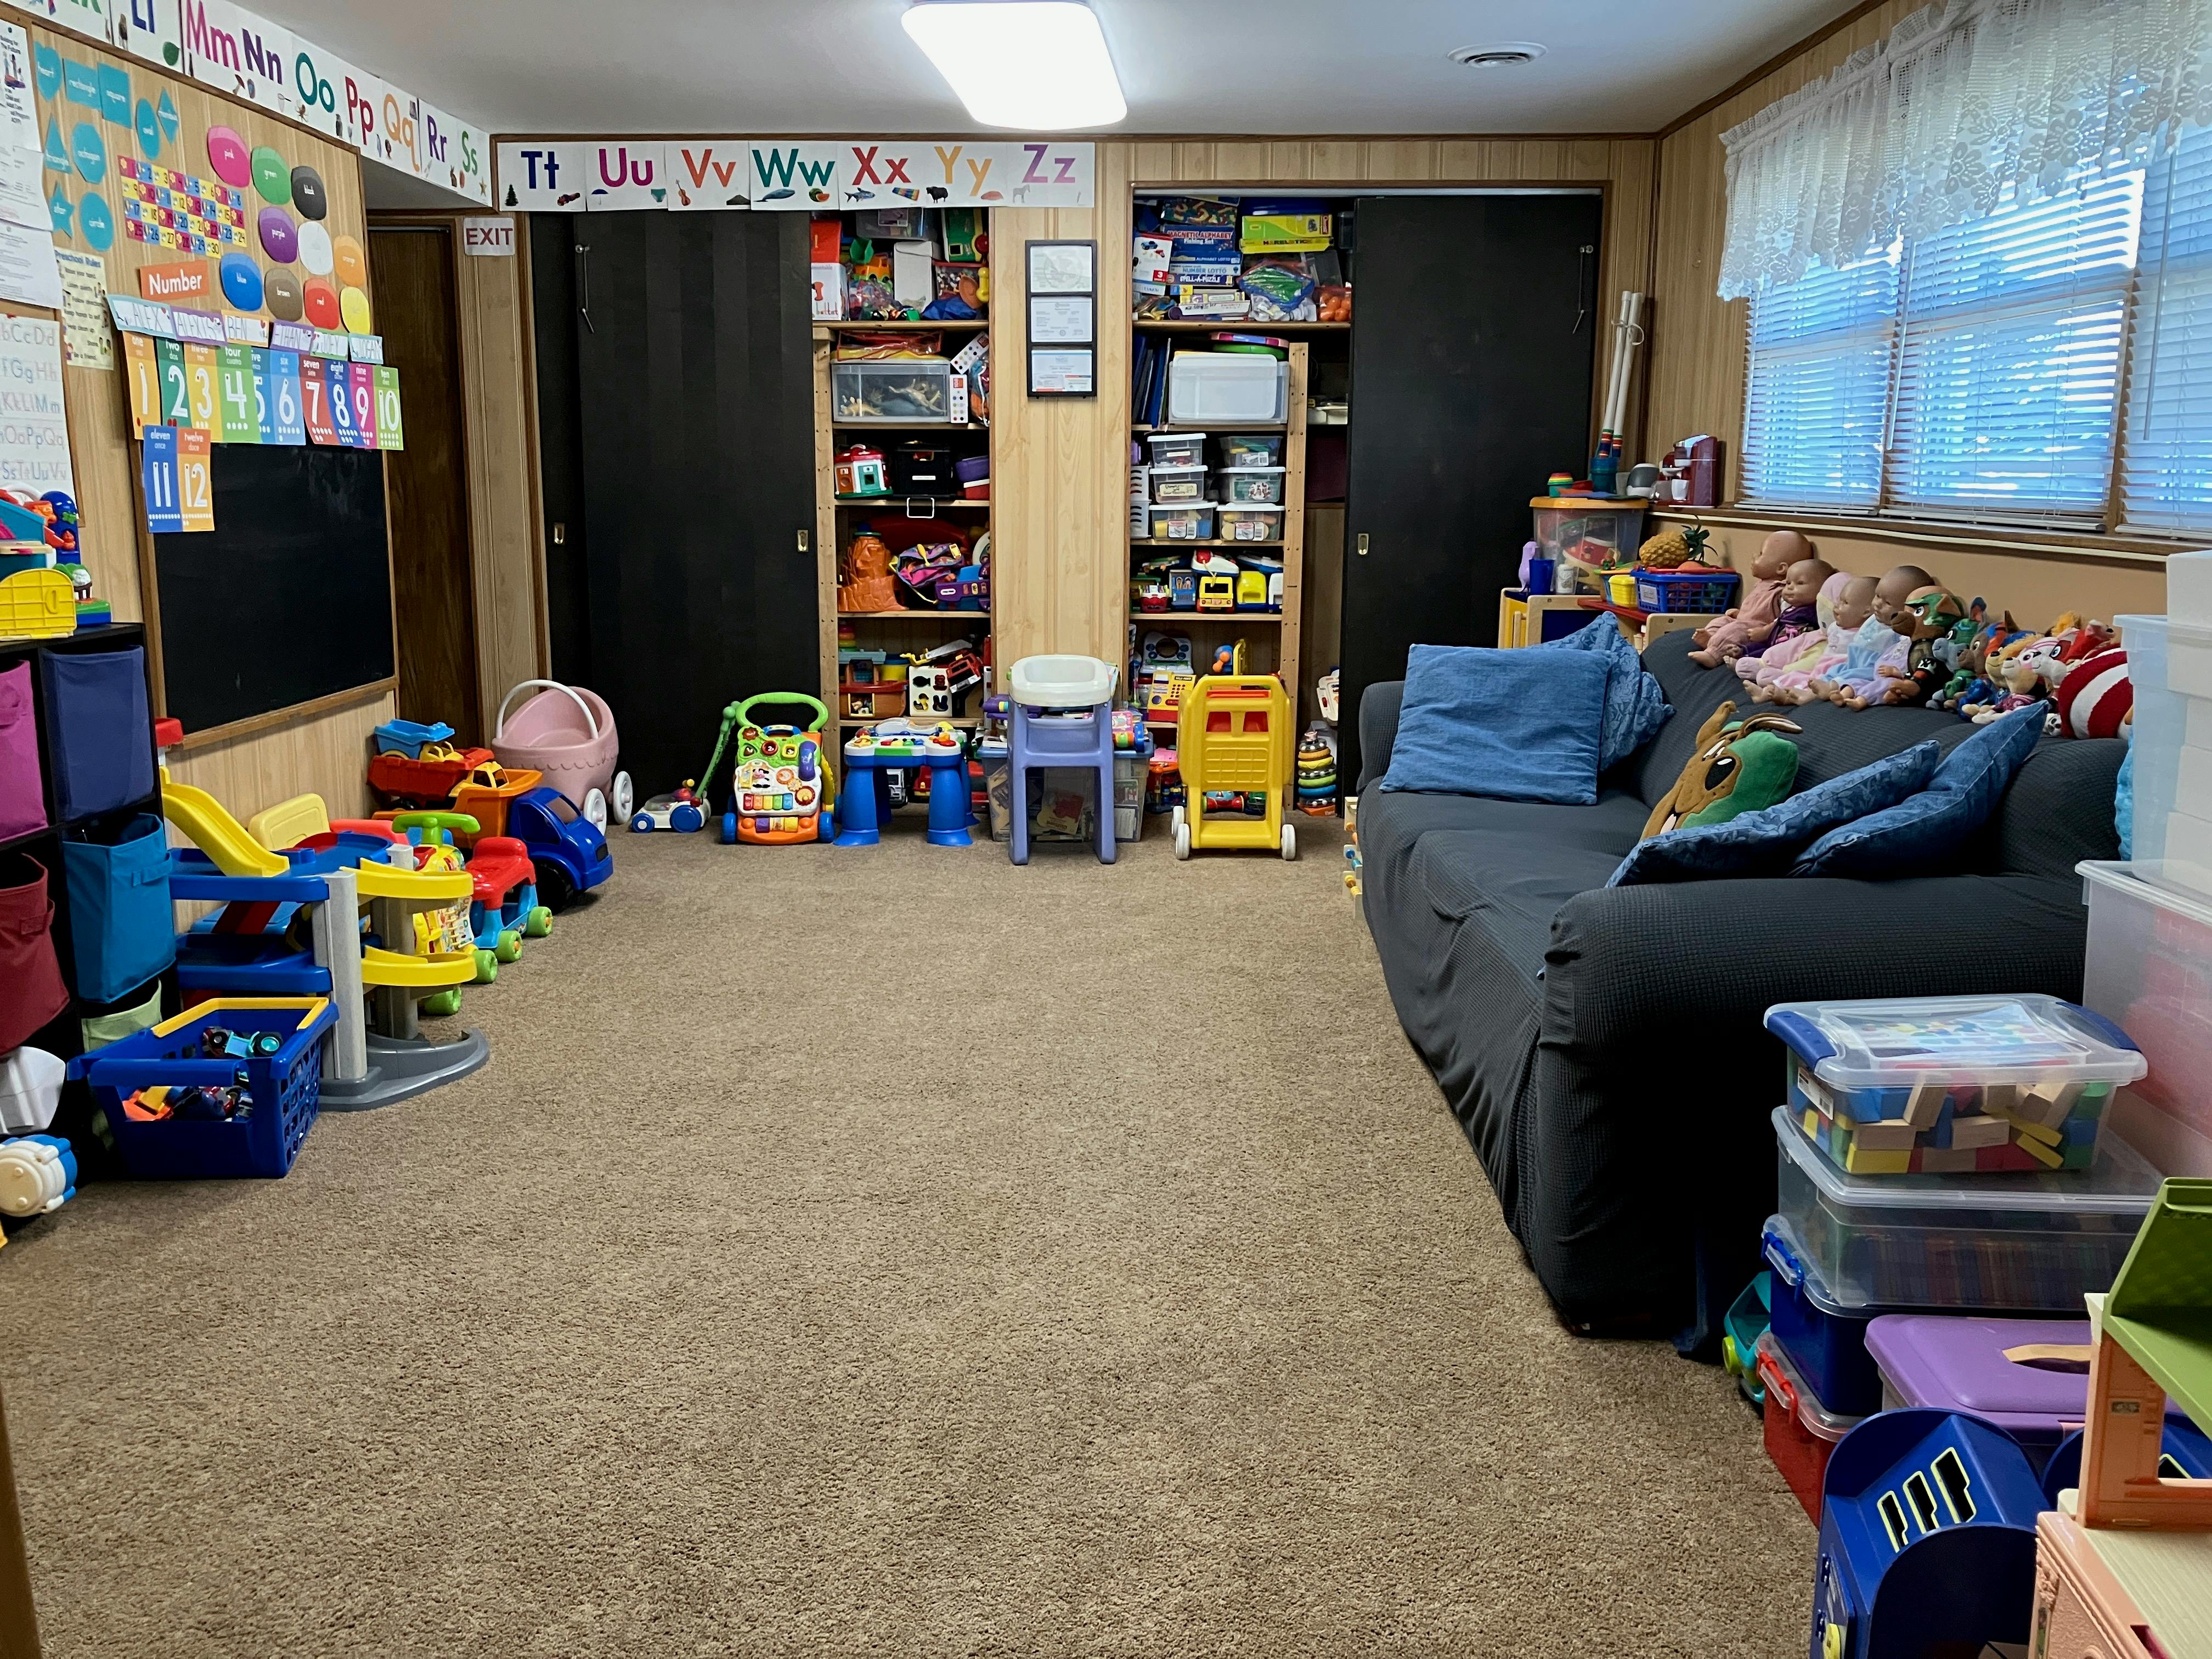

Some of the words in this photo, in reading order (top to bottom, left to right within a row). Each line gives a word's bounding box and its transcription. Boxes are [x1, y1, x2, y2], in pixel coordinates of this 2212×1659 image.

[187, 0, 241, 72] Mm
[242, 28, 283, 85] Nn
[296, 52, 335, 113] Oo
[345, 76, 374, 145] Pp
[384, 93, 420, 172] Qq
[427, 114, 447, 163] Rr
[461, 131, 478, 176] Ss
[148, 168, 152, 180] 2
[163, 173, 168, 184] 3
[194, 182, 199, 193] 5
[210, 187, 214, 197] 6
[237, 195, 241, 205] 8
[521, 151, 560, 189] Tt
[599, 148, 654, 188] Uu
[681, 149, 736, 188] Vv
[752, 148, 836, 188] Ww
[851, 146, 912, 185] Xx
[934, 145, 992, 197] Yy
[1022, 144, 1076, 184] Zz
[133, 184, 137, 193] 9
[179, 197, 185, 209] 12
[210, 205, 216, 216] 14
[134, 204, 140, 215] 17
[151, 208, 157, 221] 18
[180, 216, 188, 228] 20
[198, 220, 203, 232] 21
[225, 227, 232, 239] 23
[238, 232, 245, 243] 24
[151, 228, 159, 240] 26
[167, 232, 174, 244] 27
[197, 238, 205, 250] 29
[211, 242, 219, 254] 30
[466, 228, 514, 245] EXIT
[1167, 230, 1199, 239] MAGNETIC
[1200, 230, 1233, 240] ALPHABET
[149, 273, 202, 295] Number
[132, 302, 164, 332] ALEX
[177, 311, 217, 338] ALEXIS
[227, 315, 247, 341] BEN
[132, 335, 144, 347] one
[303, 359, 320, 369] seven
[356, 364, 366, 375] nine
[381, 369, 390, 379] ten
[138, 362, 148, 415] 1
[168, 365, 188, 418] 2
[195, 368, 212, 419] 3
[225, 370, 247, 420] 4
[253, 376, 265, 423] 5
[279, 377, 295, 425] 6
[305, 381, 320, 425] 7
[333, 383, 350, 427] 8
[356, 386, 369, 429] 9
[379, 390, 399, 431] 10
[150, 430, 171, 441] eleven
[184, 432, 204, 443] twelve
[153, 462, 171, 507] 11
[185, 463, 207, 507] 12
